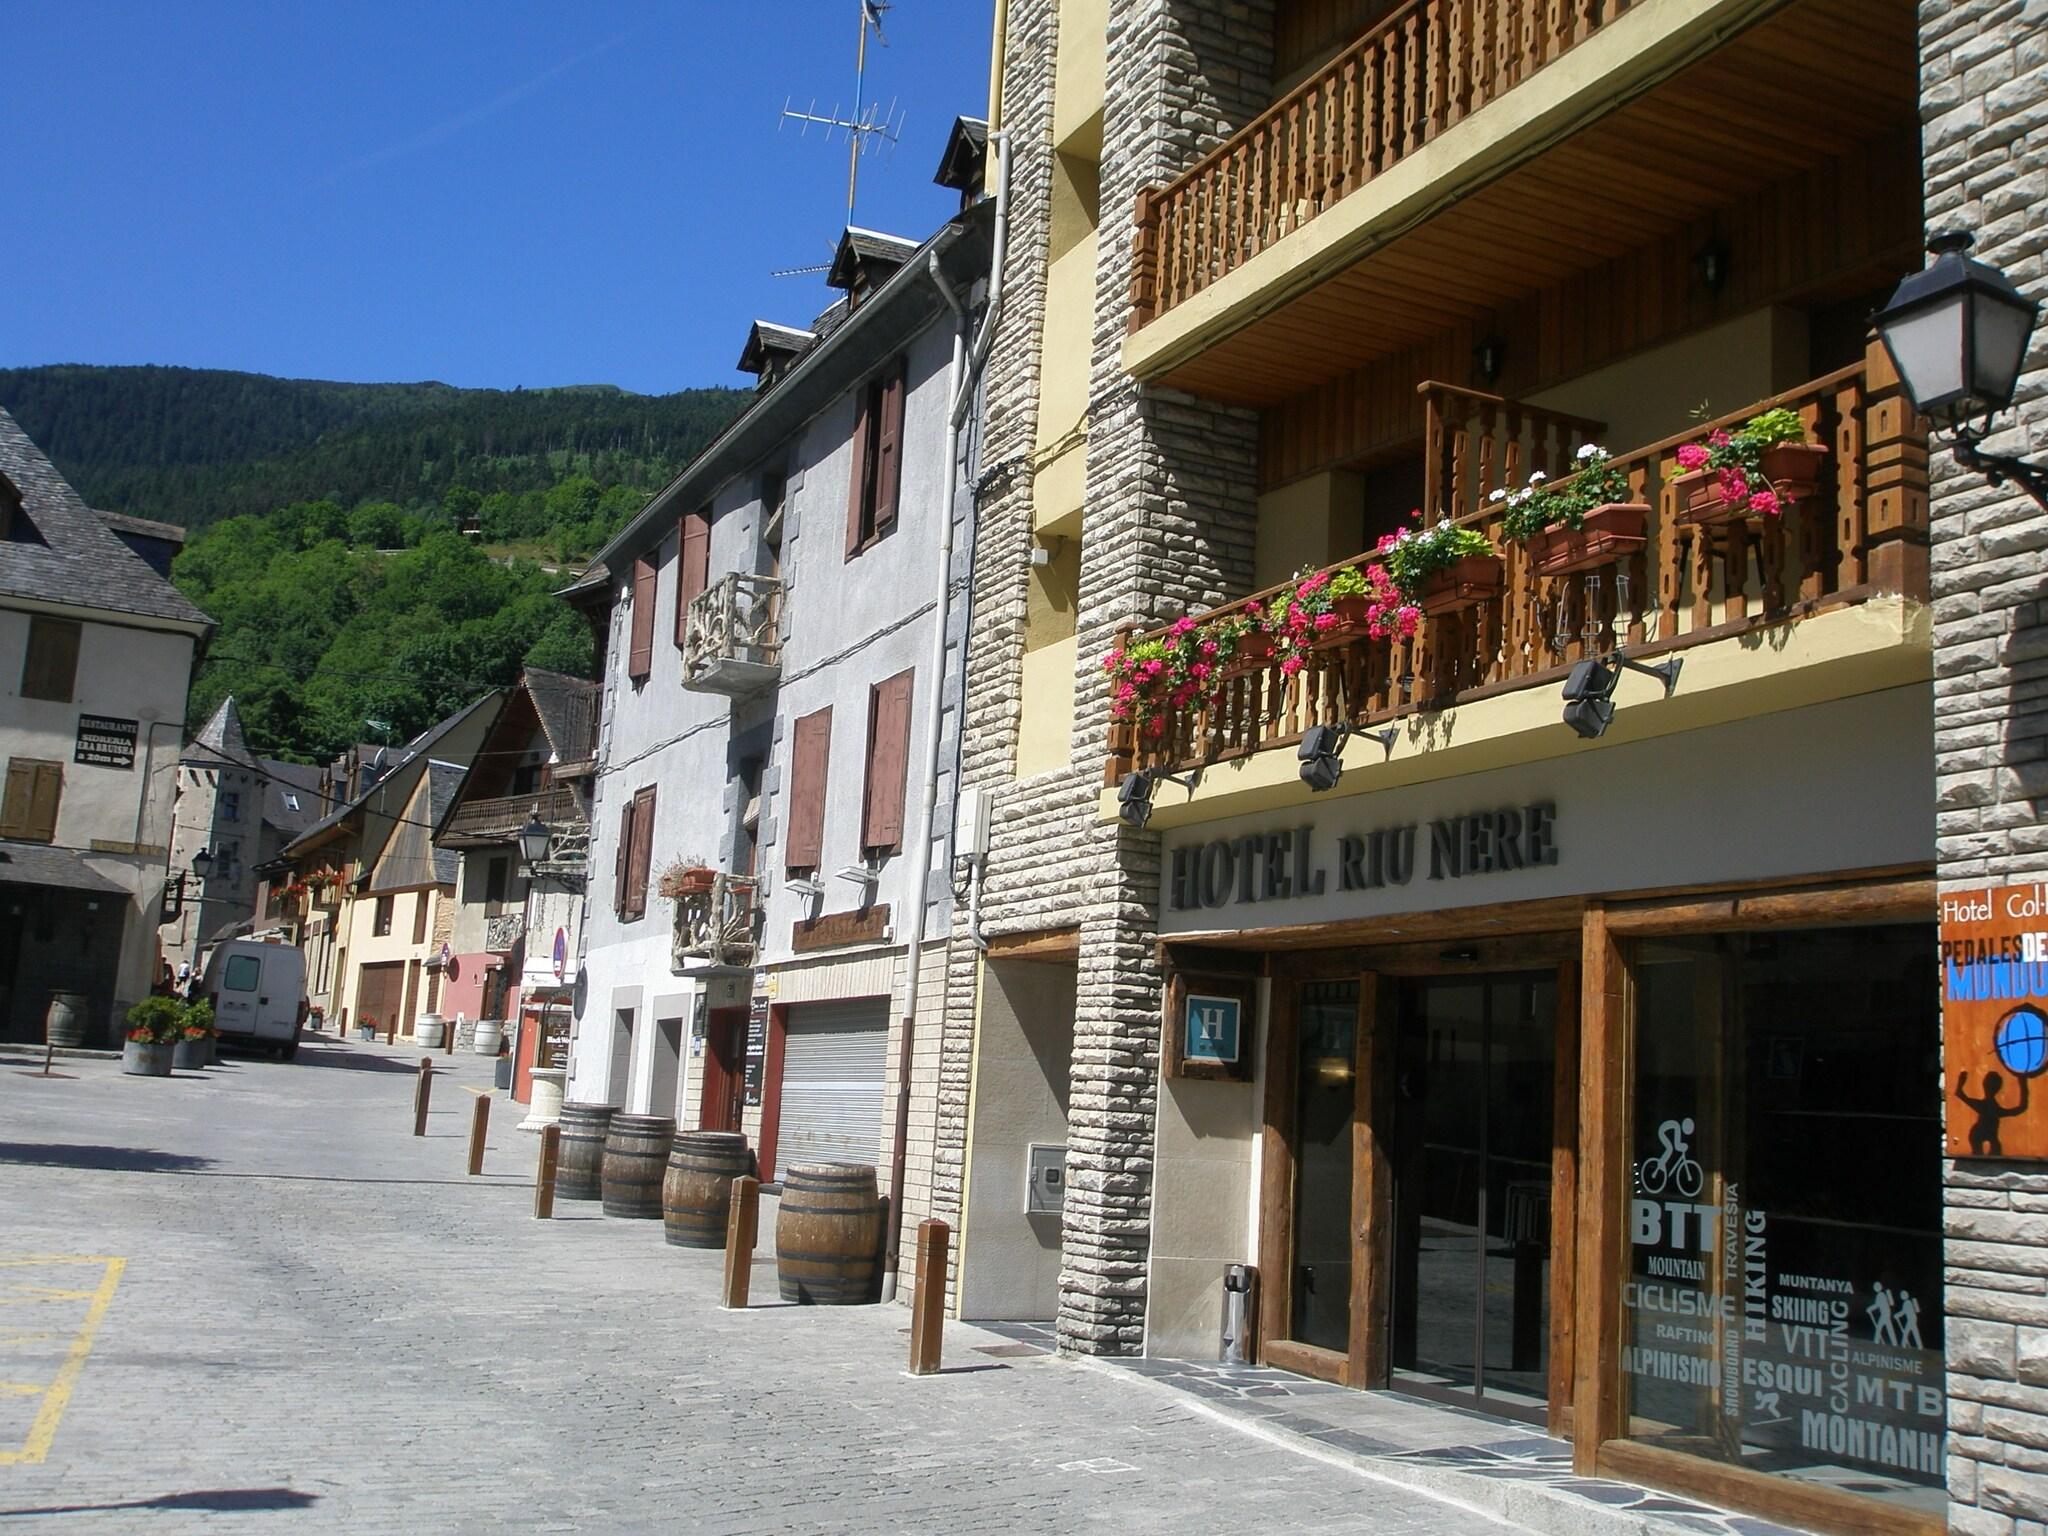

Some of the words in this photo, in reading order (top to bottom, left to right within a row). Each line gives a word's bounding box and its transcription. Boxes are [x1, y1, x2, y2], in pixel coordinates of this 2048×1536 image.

[77, 740, 95, 751] ERA
[81, 734, 131, 745] SIDRERIA
[1168, 825, 1325, 911] HOTEL
[1336, 823, 1418, 892] RIU
[1427, 802, 1558, 880] NERE
[1943, 888, 1993, 923] Hotel
[1942, 935, 2023, 968] PEDALES
[1200, 1007, 1225, 1040] H
[1631, 1199, 1721, 1252] BTT
[1725, 1183, 1739, 1280] TRAVESIA
[1648, 1256, 1706, 1281] MOUNTAIN
[1744, 1210, 1767, 1344] HIKING
[1779, 1273, 1855, 1294] MUNTANYA
[1622, 1282, 1736, 1322] CICLISME
[1772, 1295, 1829, 1326] SKIING
[1782, 1323, 1829, 1360] VTT
[1830, 1300, 1849, 1414] CYCLING
[1622, 1345, 1721, 1388] ALPINISMO
[1725, 1329, 1739, 1416] SNOWBOARD
[1743, 1358, 1822, 1398] ESQUI
[1852, 1351, 1923, 1376] ALPINISME
[1856, 1375, 1943, 1416] MTB
